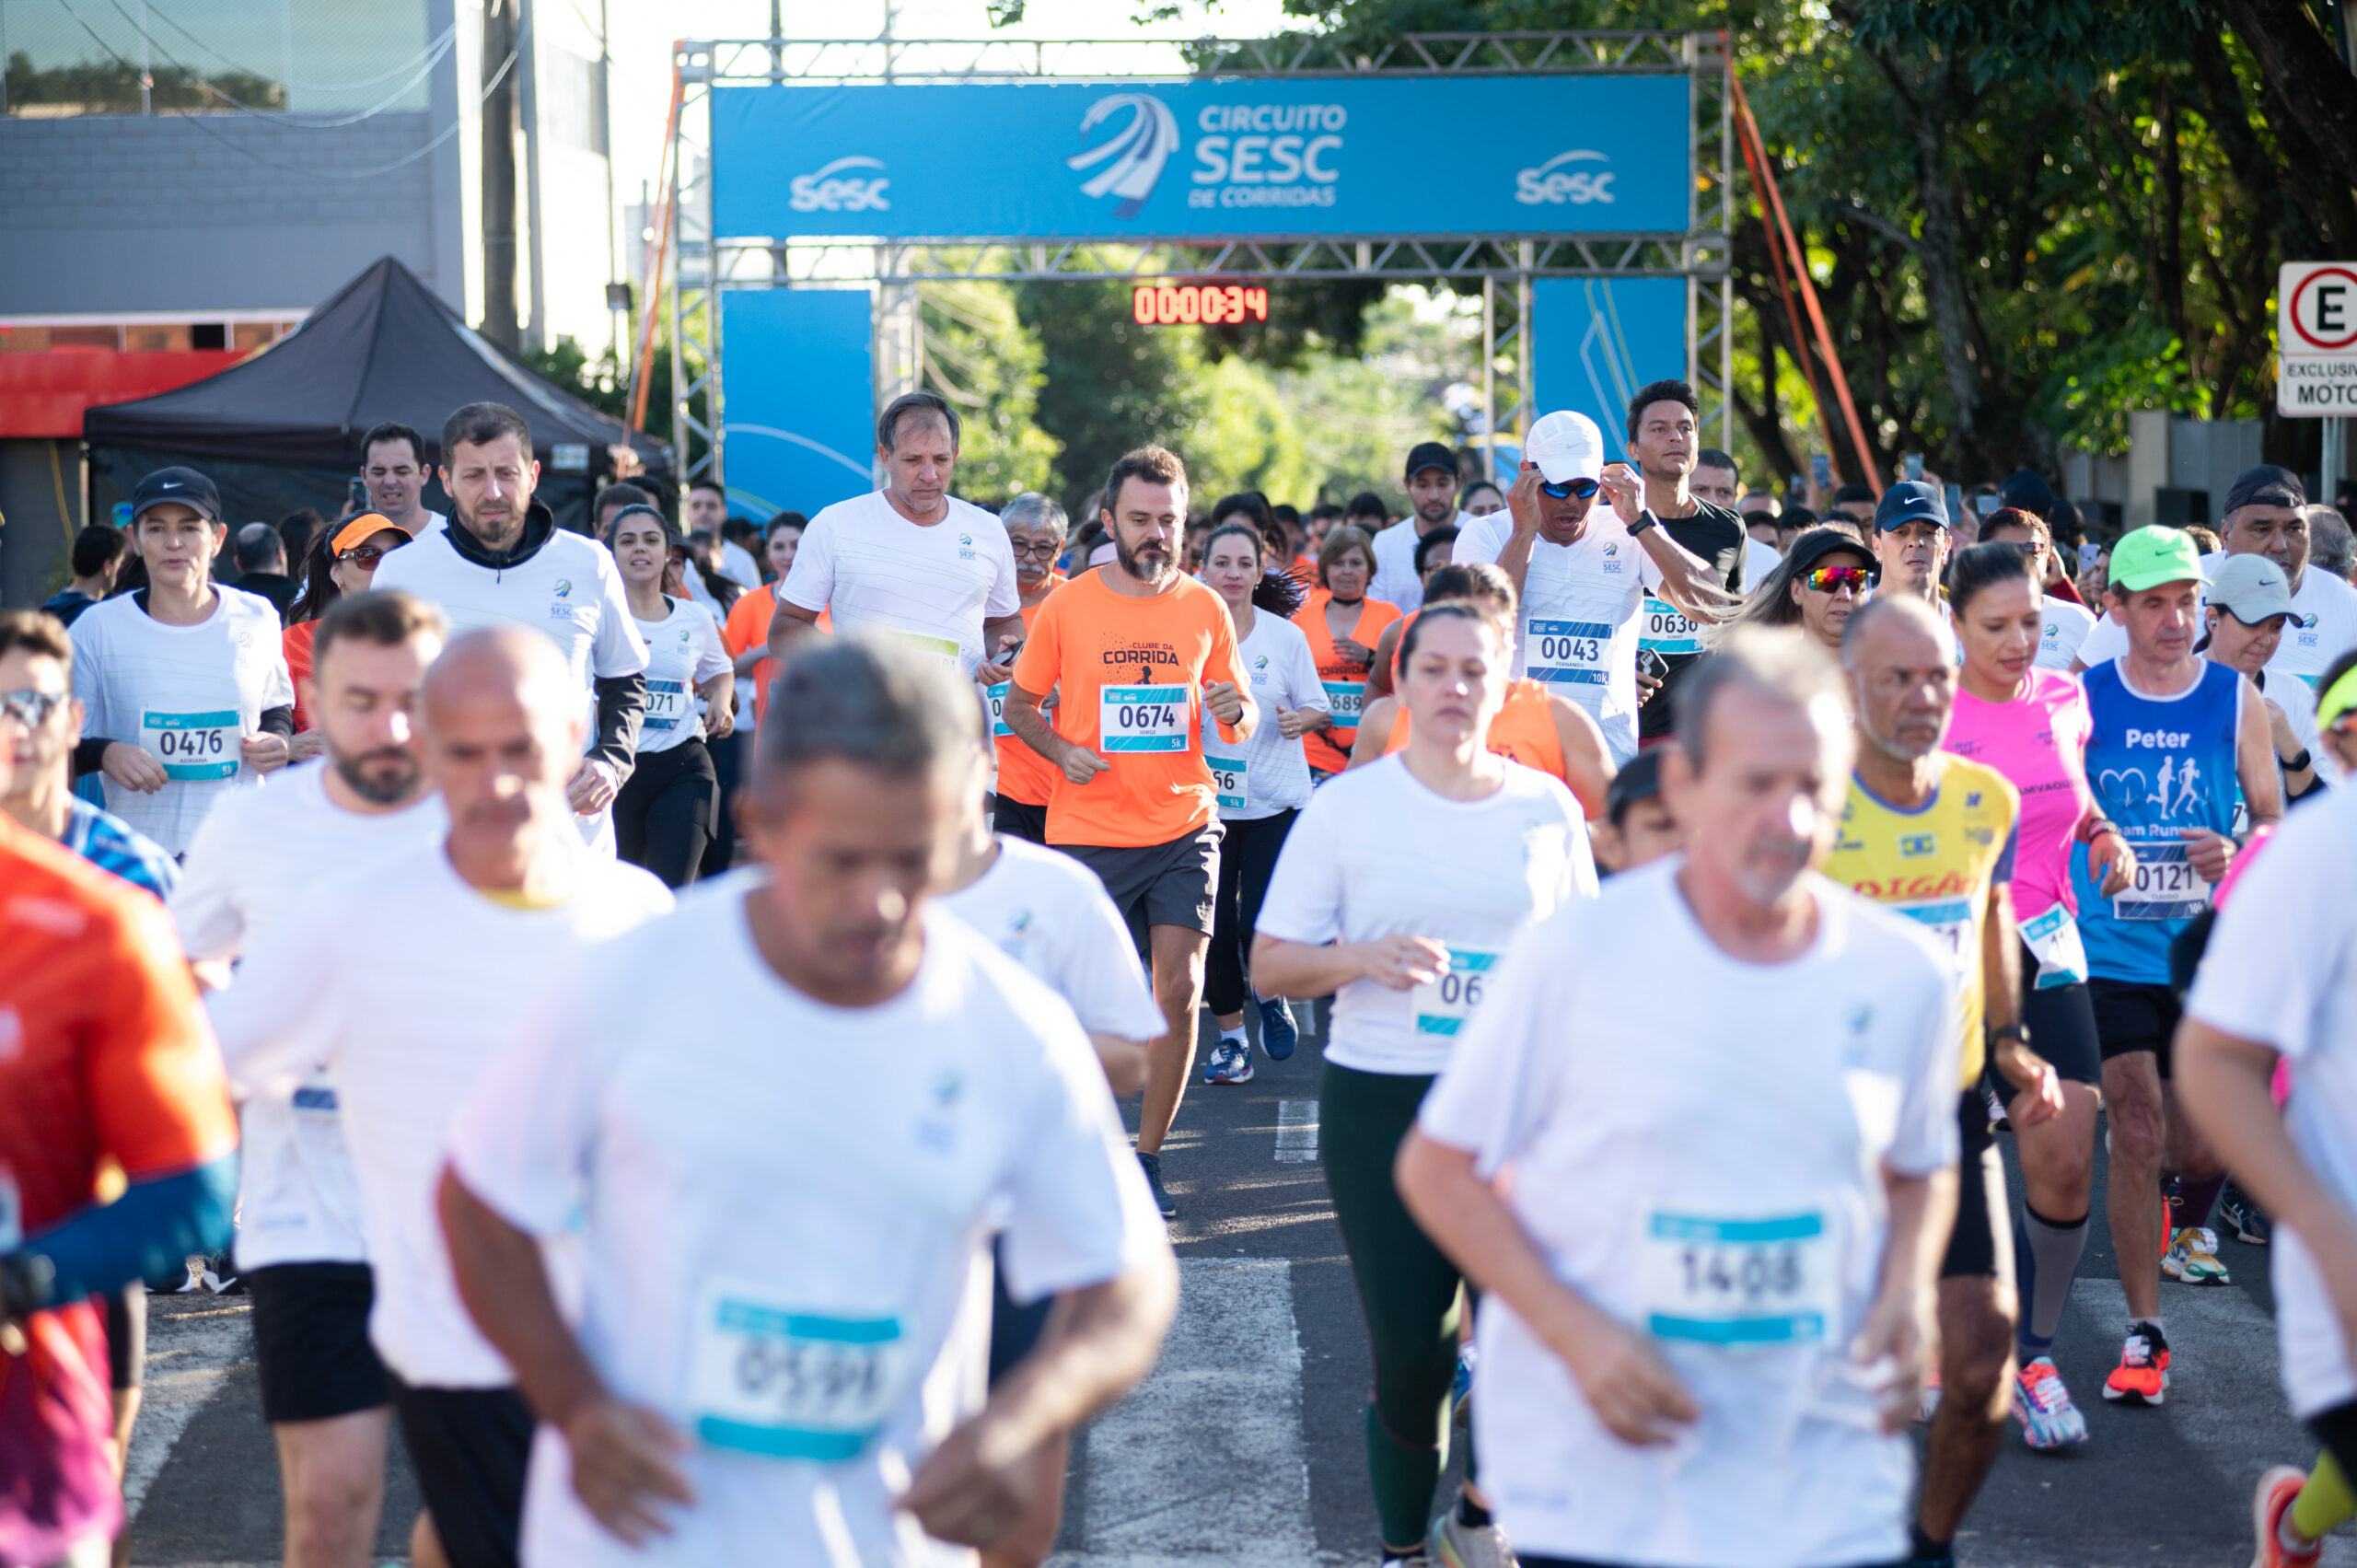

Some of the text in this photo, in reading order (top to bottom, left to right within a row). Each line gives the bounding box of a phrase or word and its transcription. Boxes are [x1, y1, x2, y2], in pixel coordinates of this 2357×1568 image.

[1199, 104, 1347, 132] CIRCUITO
[1192, 135, 1342, 183] SESC
[1189, 185, 1336, 208] DE CORRIDAS
[2317, 285, 2346, 331] E
[1651, 614, 1698, 633] 0636
[1103, 650, 1179, 666] CORRIDA
[1541, 636, 1599, 662] 0043
[1119, 705, 1175, 728] 0674
[159, 728, 223, 755] 0476
[1171, 738, 1181, 748] 5k
[2126, 728, 2190, 749] Peter
[2135, 865, 2192, 891] 0121
